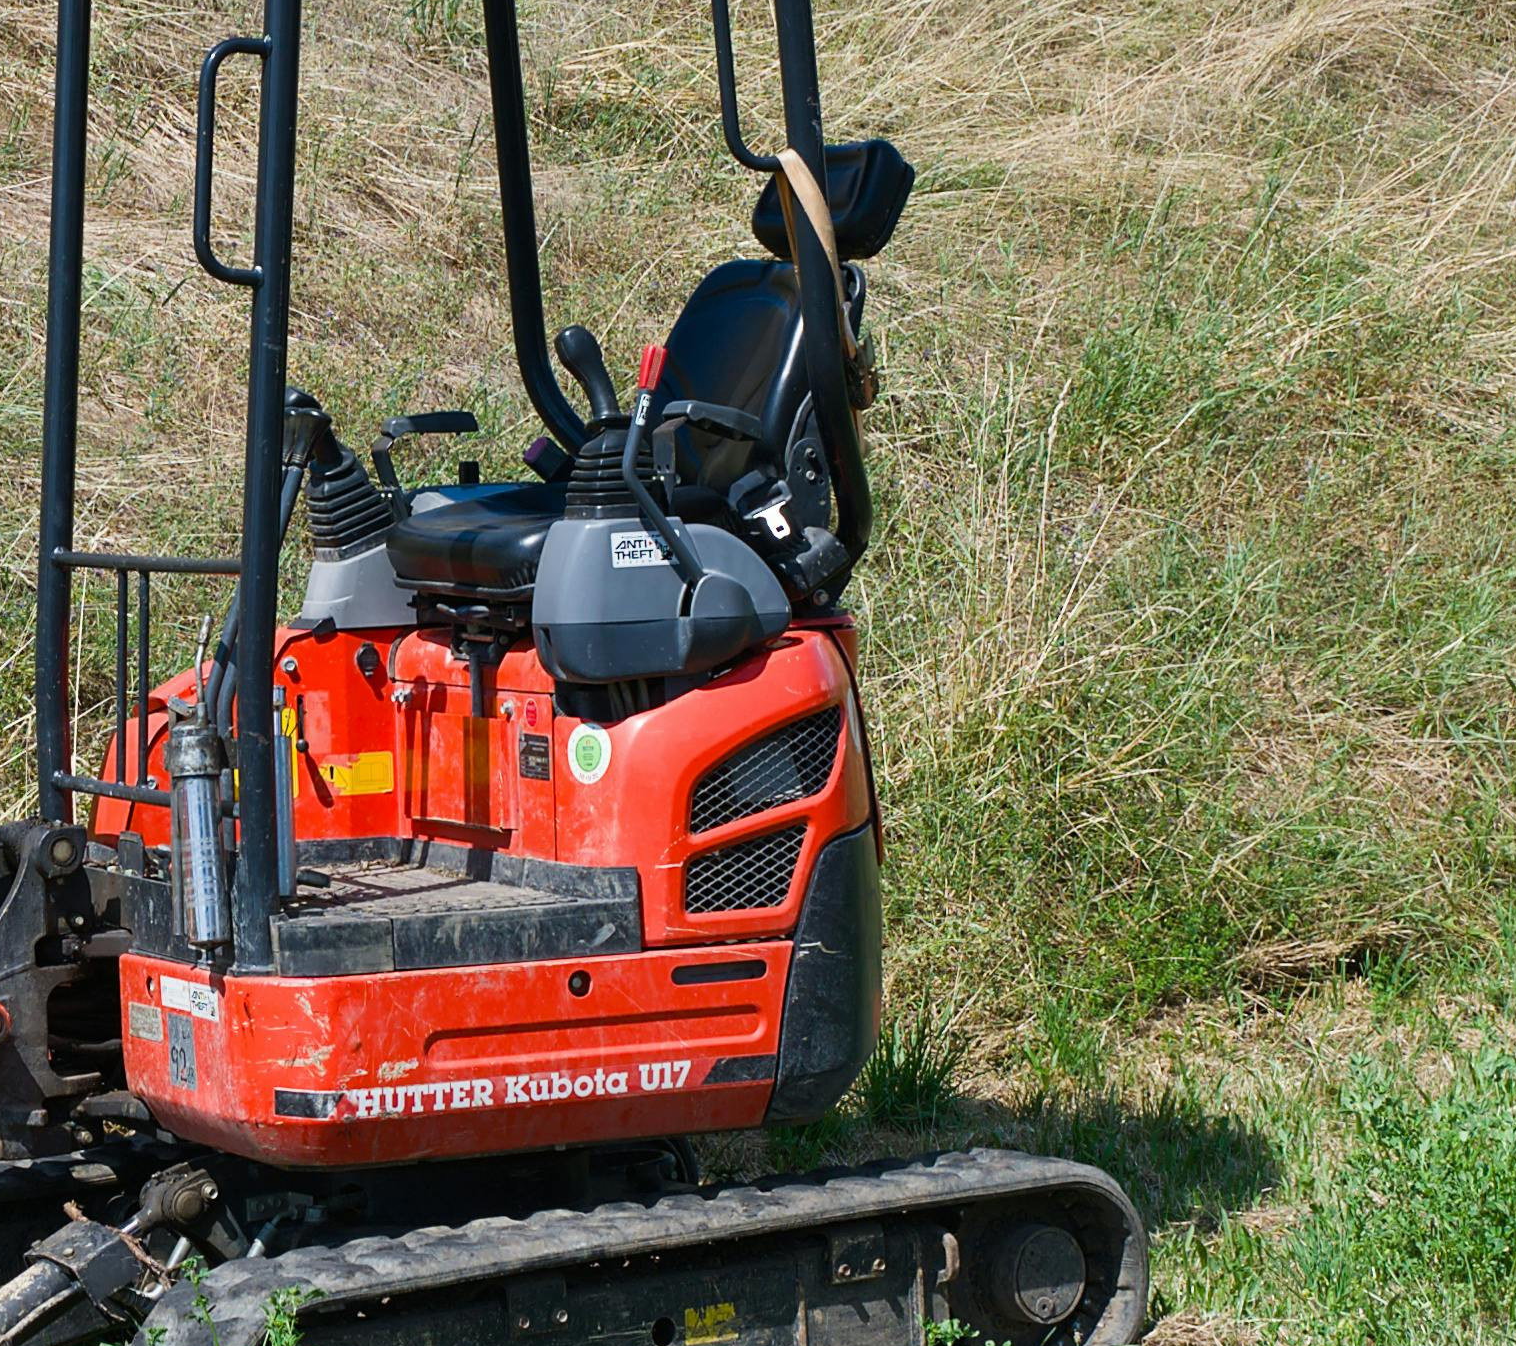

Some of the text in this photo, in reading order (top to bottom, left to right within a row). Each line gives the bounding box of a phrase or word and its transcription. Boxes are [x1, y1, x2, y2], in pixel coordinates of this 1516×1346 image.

[616, 540, 647, 549] ANTI
[614, 550, 654, 560] THEFT
[354, 1060, 693, 1117] HUTTER Kubota U17
